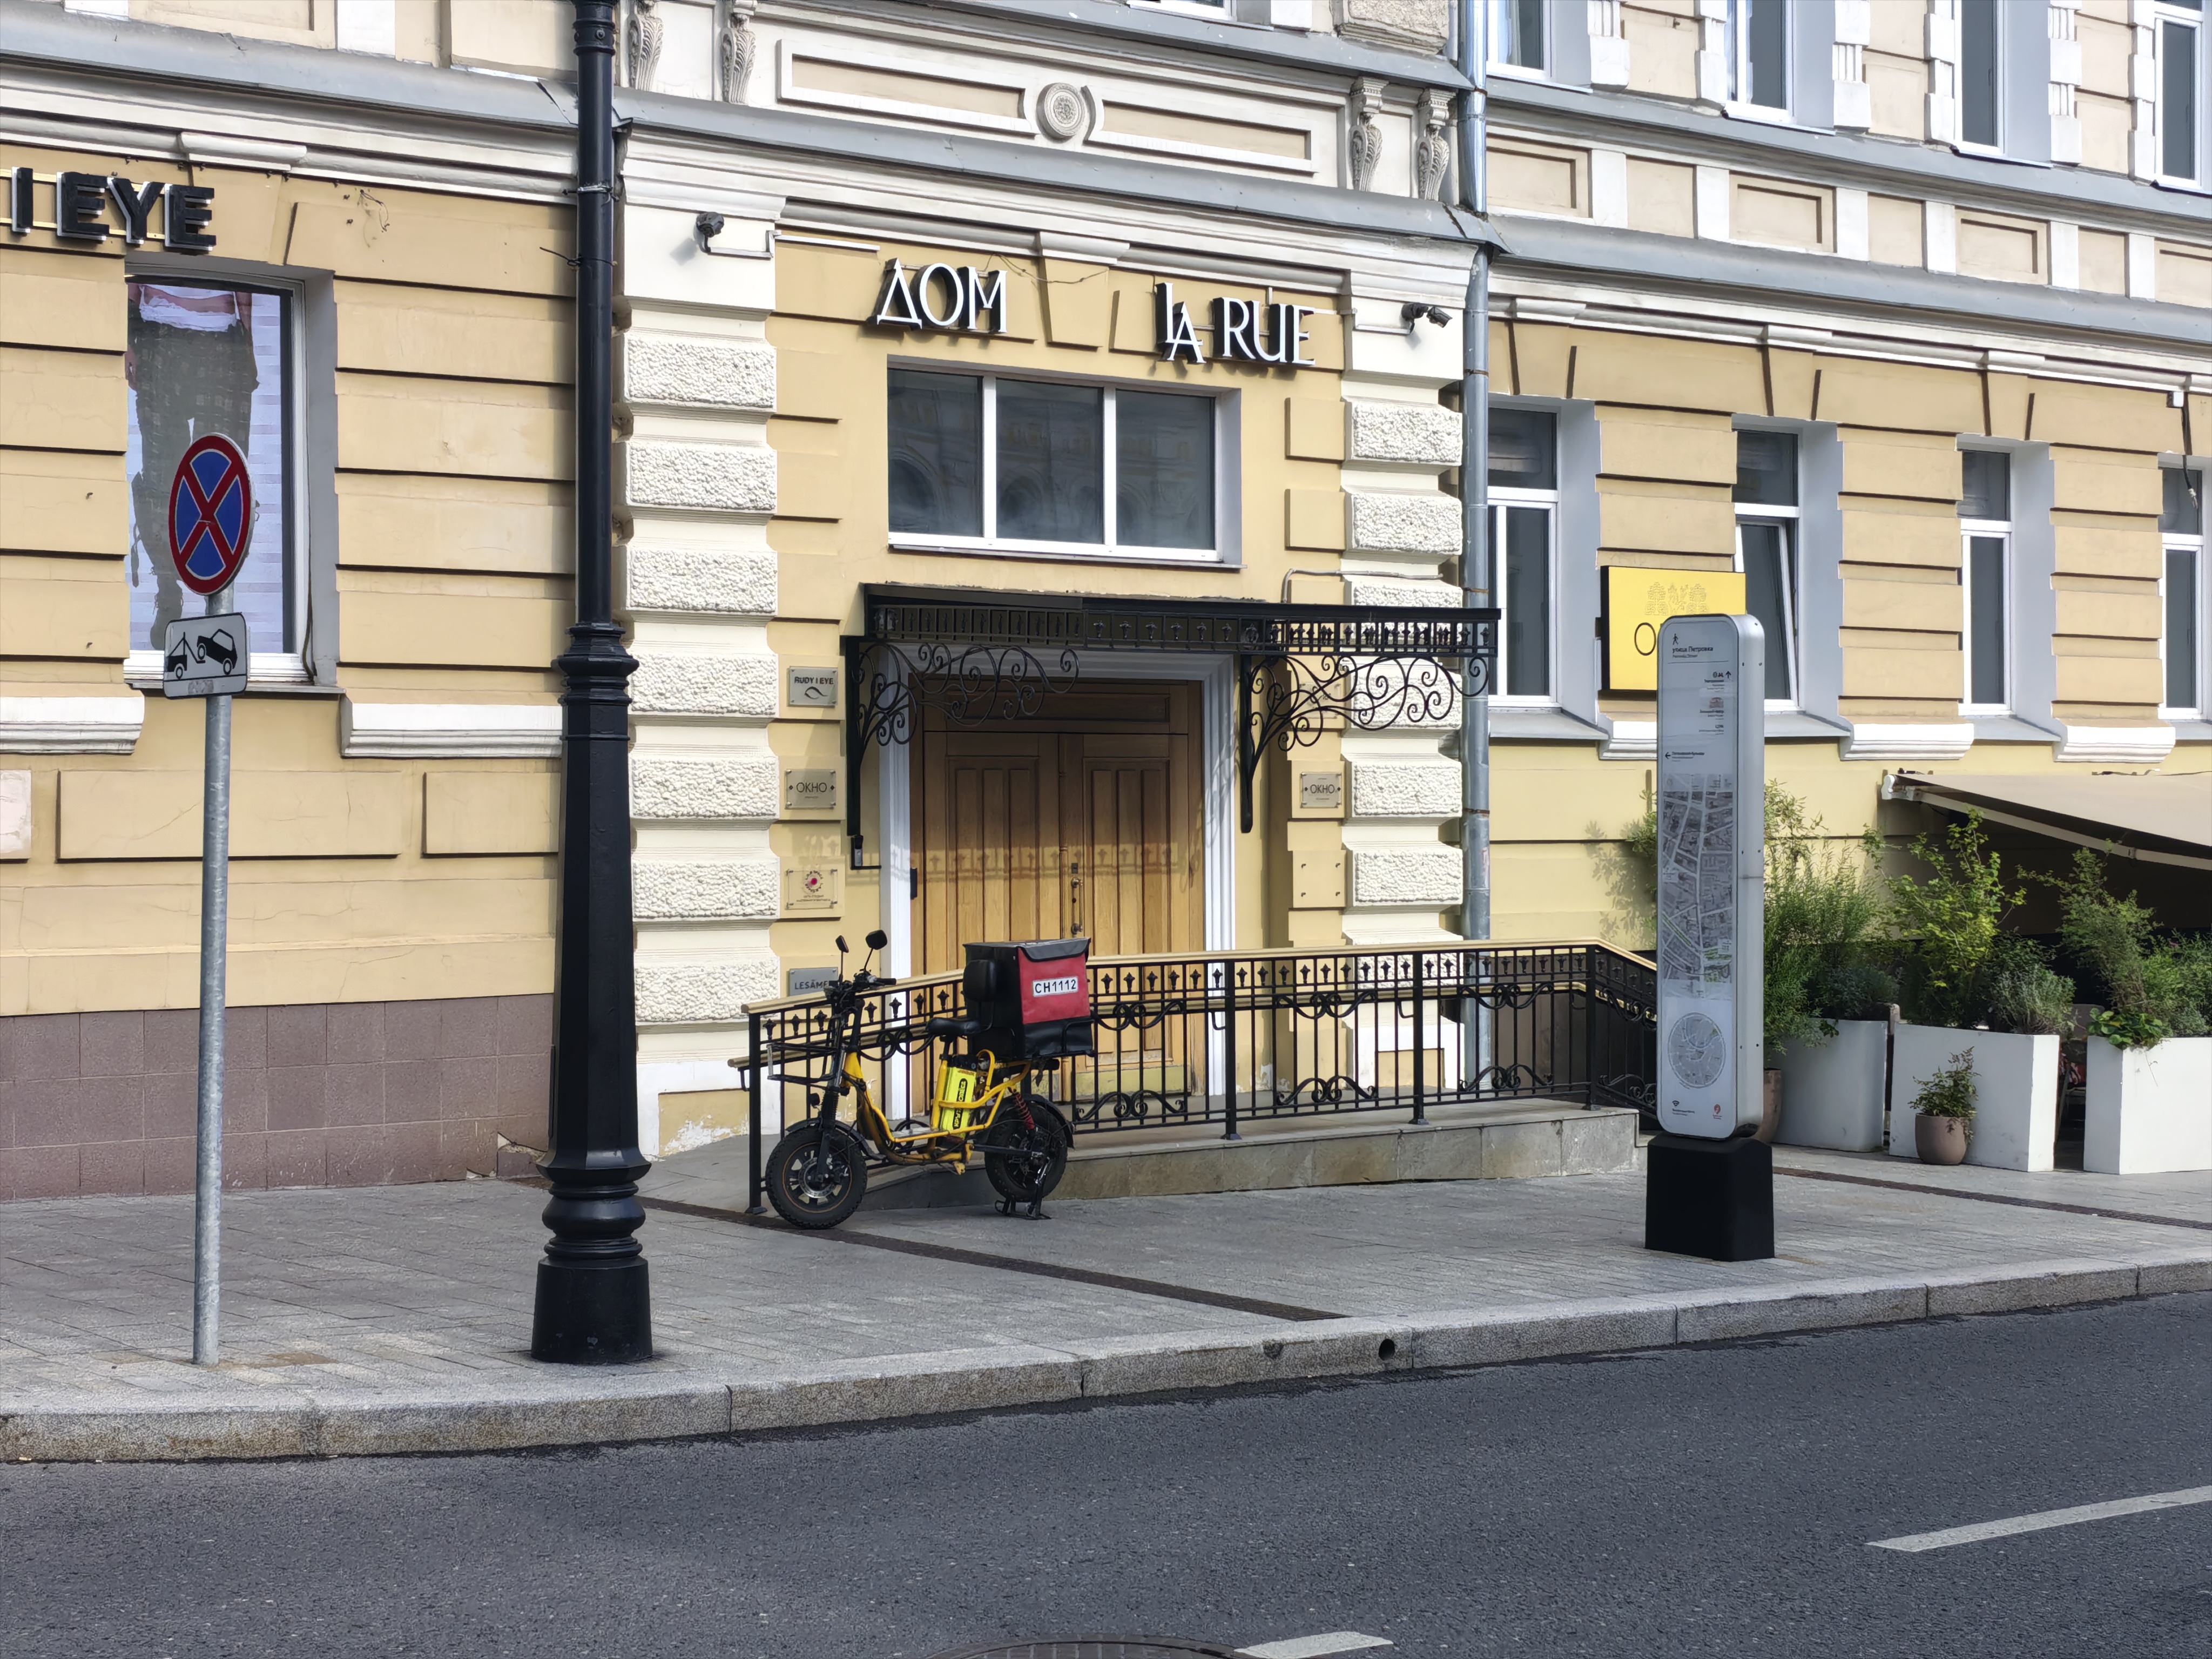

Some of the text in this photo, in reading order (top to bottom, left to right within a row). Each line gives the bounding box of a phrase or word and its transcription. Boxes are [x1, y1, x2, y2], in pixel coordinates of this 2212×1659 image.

[57, 171, 217, 251] EYE
[874, 258, 1008, 333] ДОМ
[1160, 282, 1316, 366] LA RUE
[797, 782, 827, 792] ОКНО
[1310, 784, 1335, 794] ОКНО
[1035, 979, 1076, 993] CH1112
